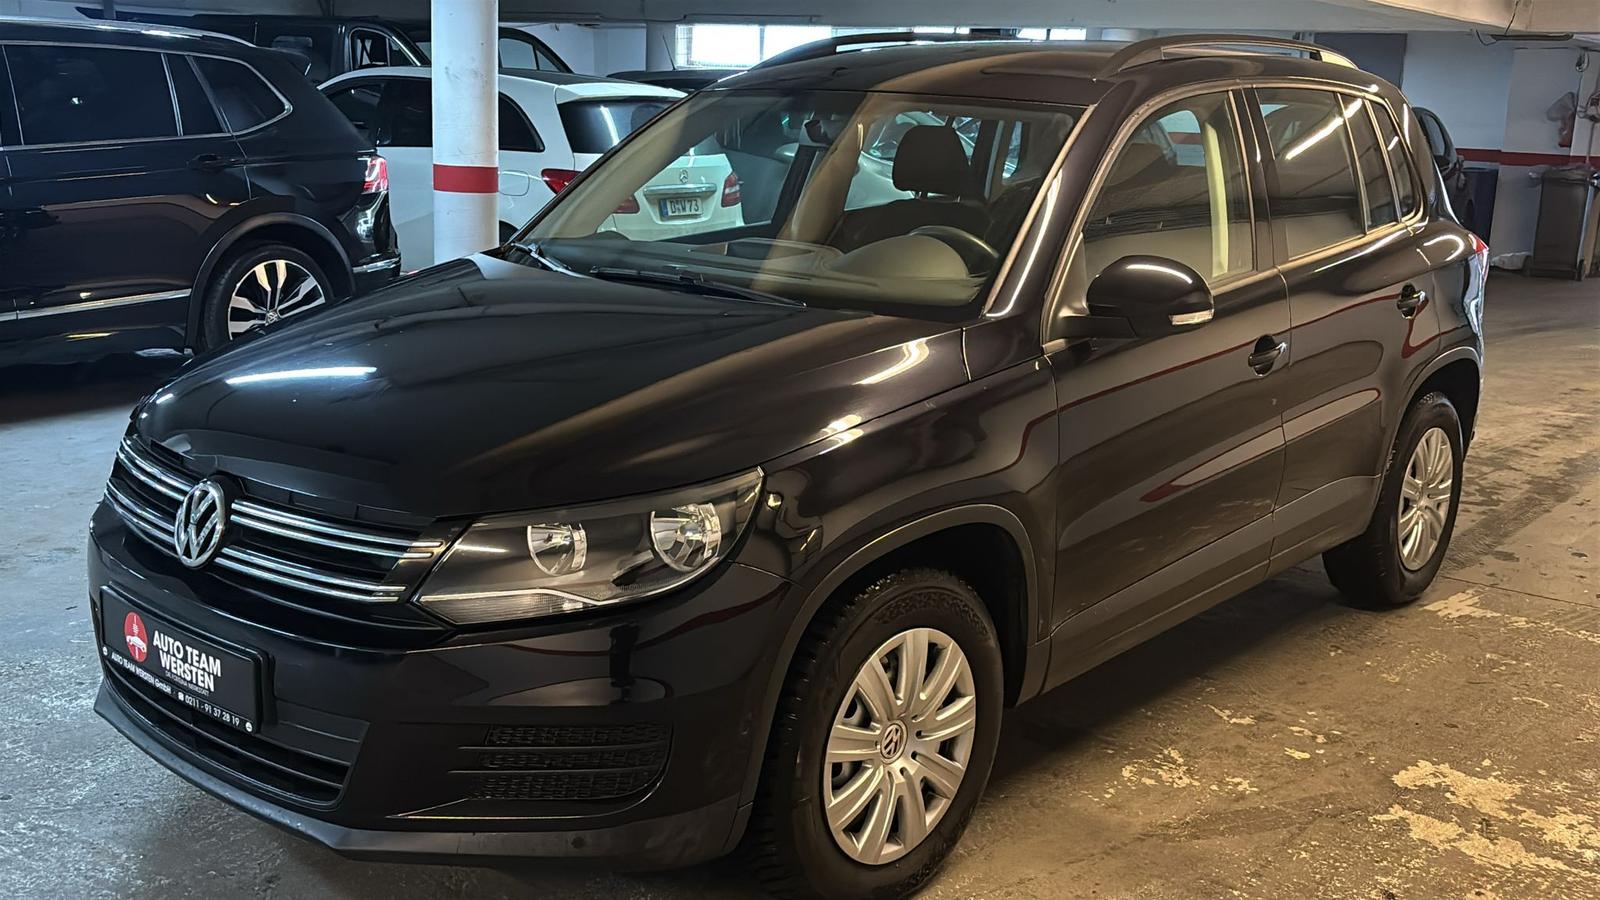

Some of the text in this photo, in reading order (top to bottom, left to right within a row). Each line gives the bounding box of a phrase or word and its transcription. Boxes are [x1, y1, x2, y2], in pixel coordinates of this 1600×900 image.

[152, 630, 221, 677] AUTO TEAM
[159, 649, 215, 692] WERSTEN
[185, 694, 200, 709] 0211
[232, 715, 240, 727] 19
